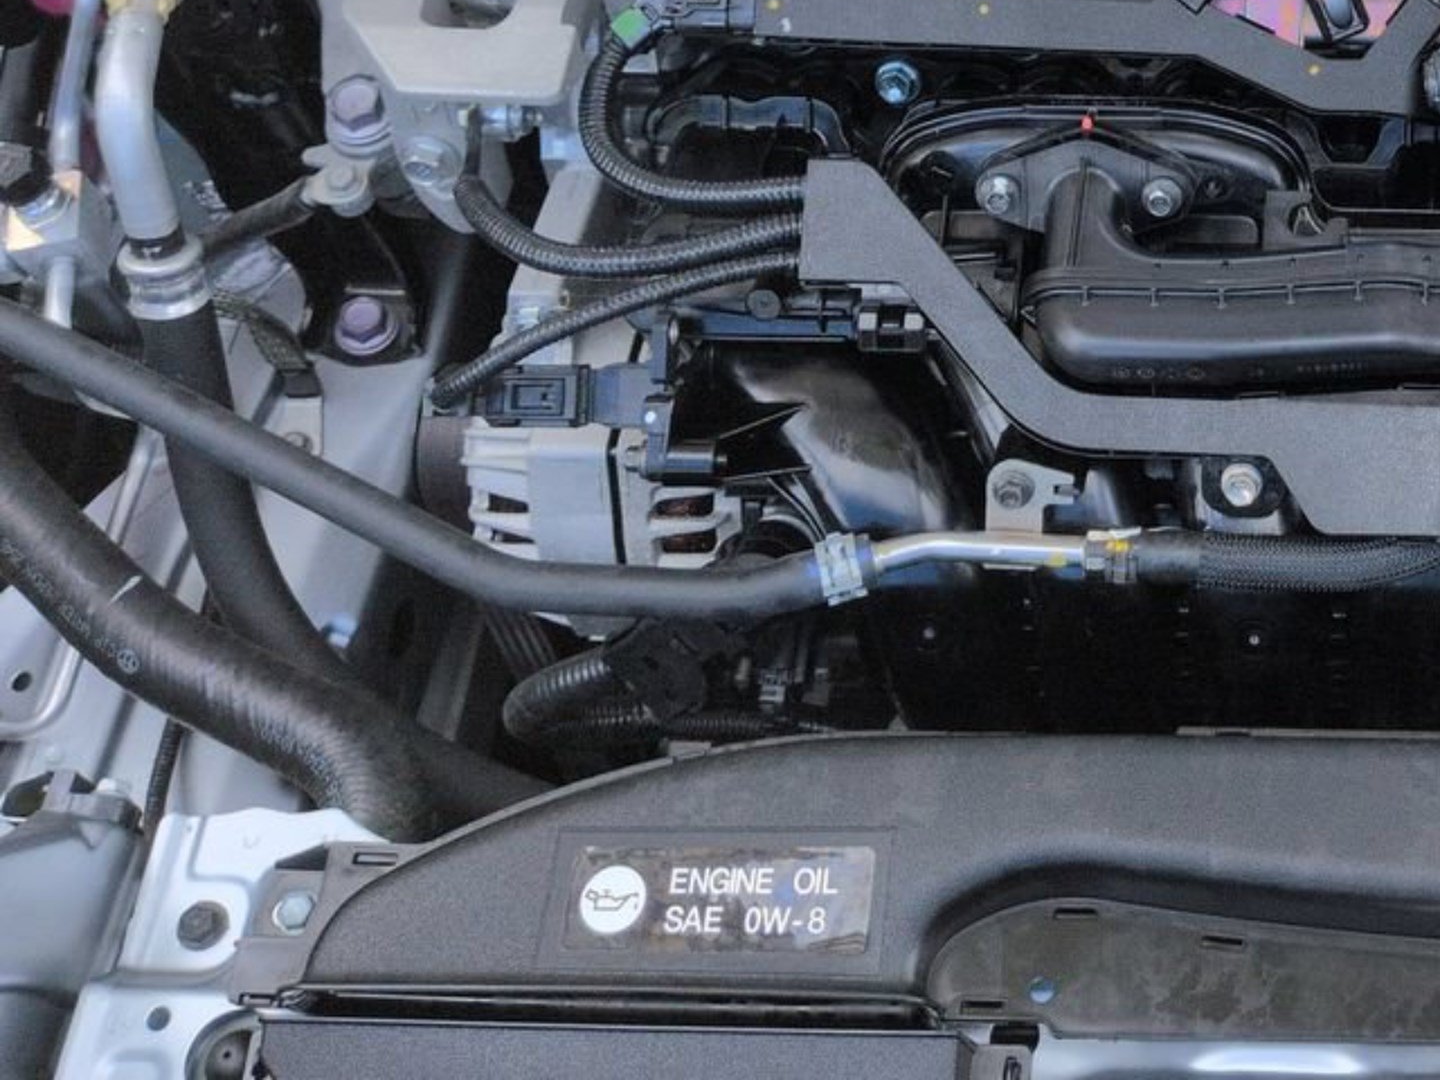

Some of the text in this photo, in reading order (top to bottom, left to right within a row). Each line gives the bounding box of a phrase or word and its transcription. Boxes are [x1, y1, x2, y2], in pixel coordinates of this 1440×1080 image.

[669, 867, 838, 895] ENGINE OIL
[663, 905, 826, 934] SAE 0W-8
